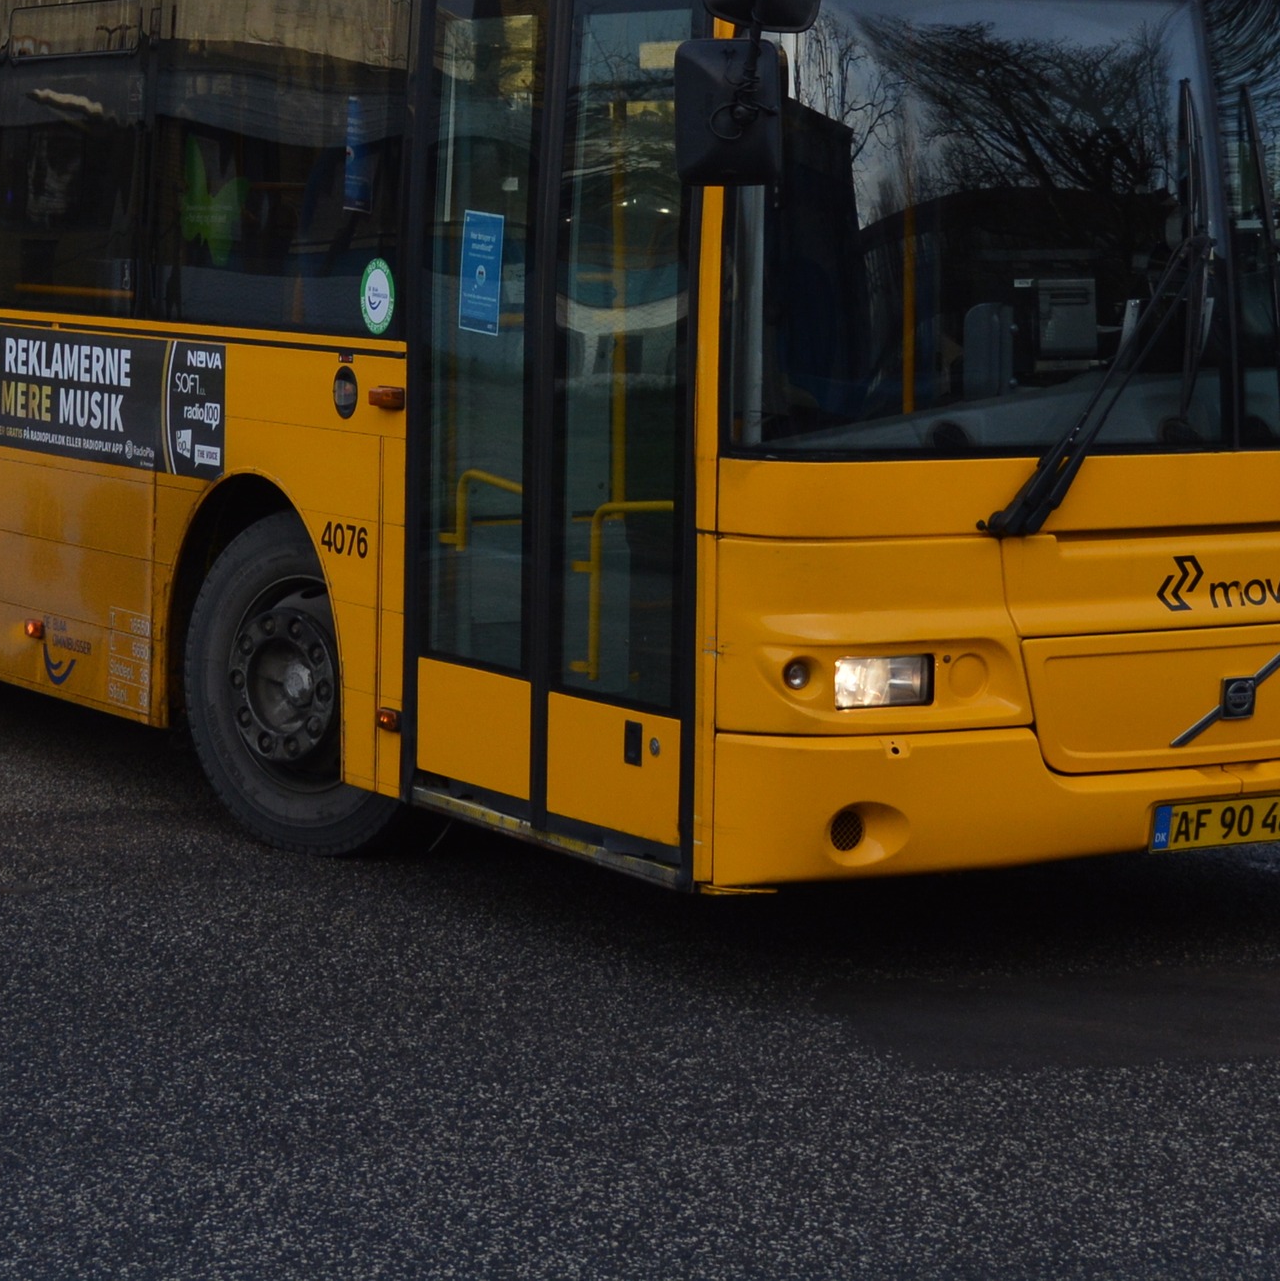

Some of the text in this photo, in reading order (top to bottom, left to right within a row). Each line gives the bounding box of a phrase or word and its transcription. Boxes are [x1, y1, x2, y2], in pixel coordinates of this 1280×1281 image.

[5, 339, 132, 388] REKLAMERNE
[187, 350, 222, 370] NOVA
[0, 380, 52, 422] MERE
[58, 387, 125, 433] MUSIK
[23, 427, 30, 440] PÅ
[30, 430, 65, 446] RADIOPLAY.DK
[66, 436, 82, 448] ELLER
[82, 438, 111, 453] RADIOPLAY
[112, 443, 123, 454] APP
[196, 449, 219, 461] THE VOICE
[320, 520, 369, 559] 4076
[1154, 832, 1168, 844] DK
[1172, 808, 1212, 844] AF
[1222, 804, 1254, 838] 90
